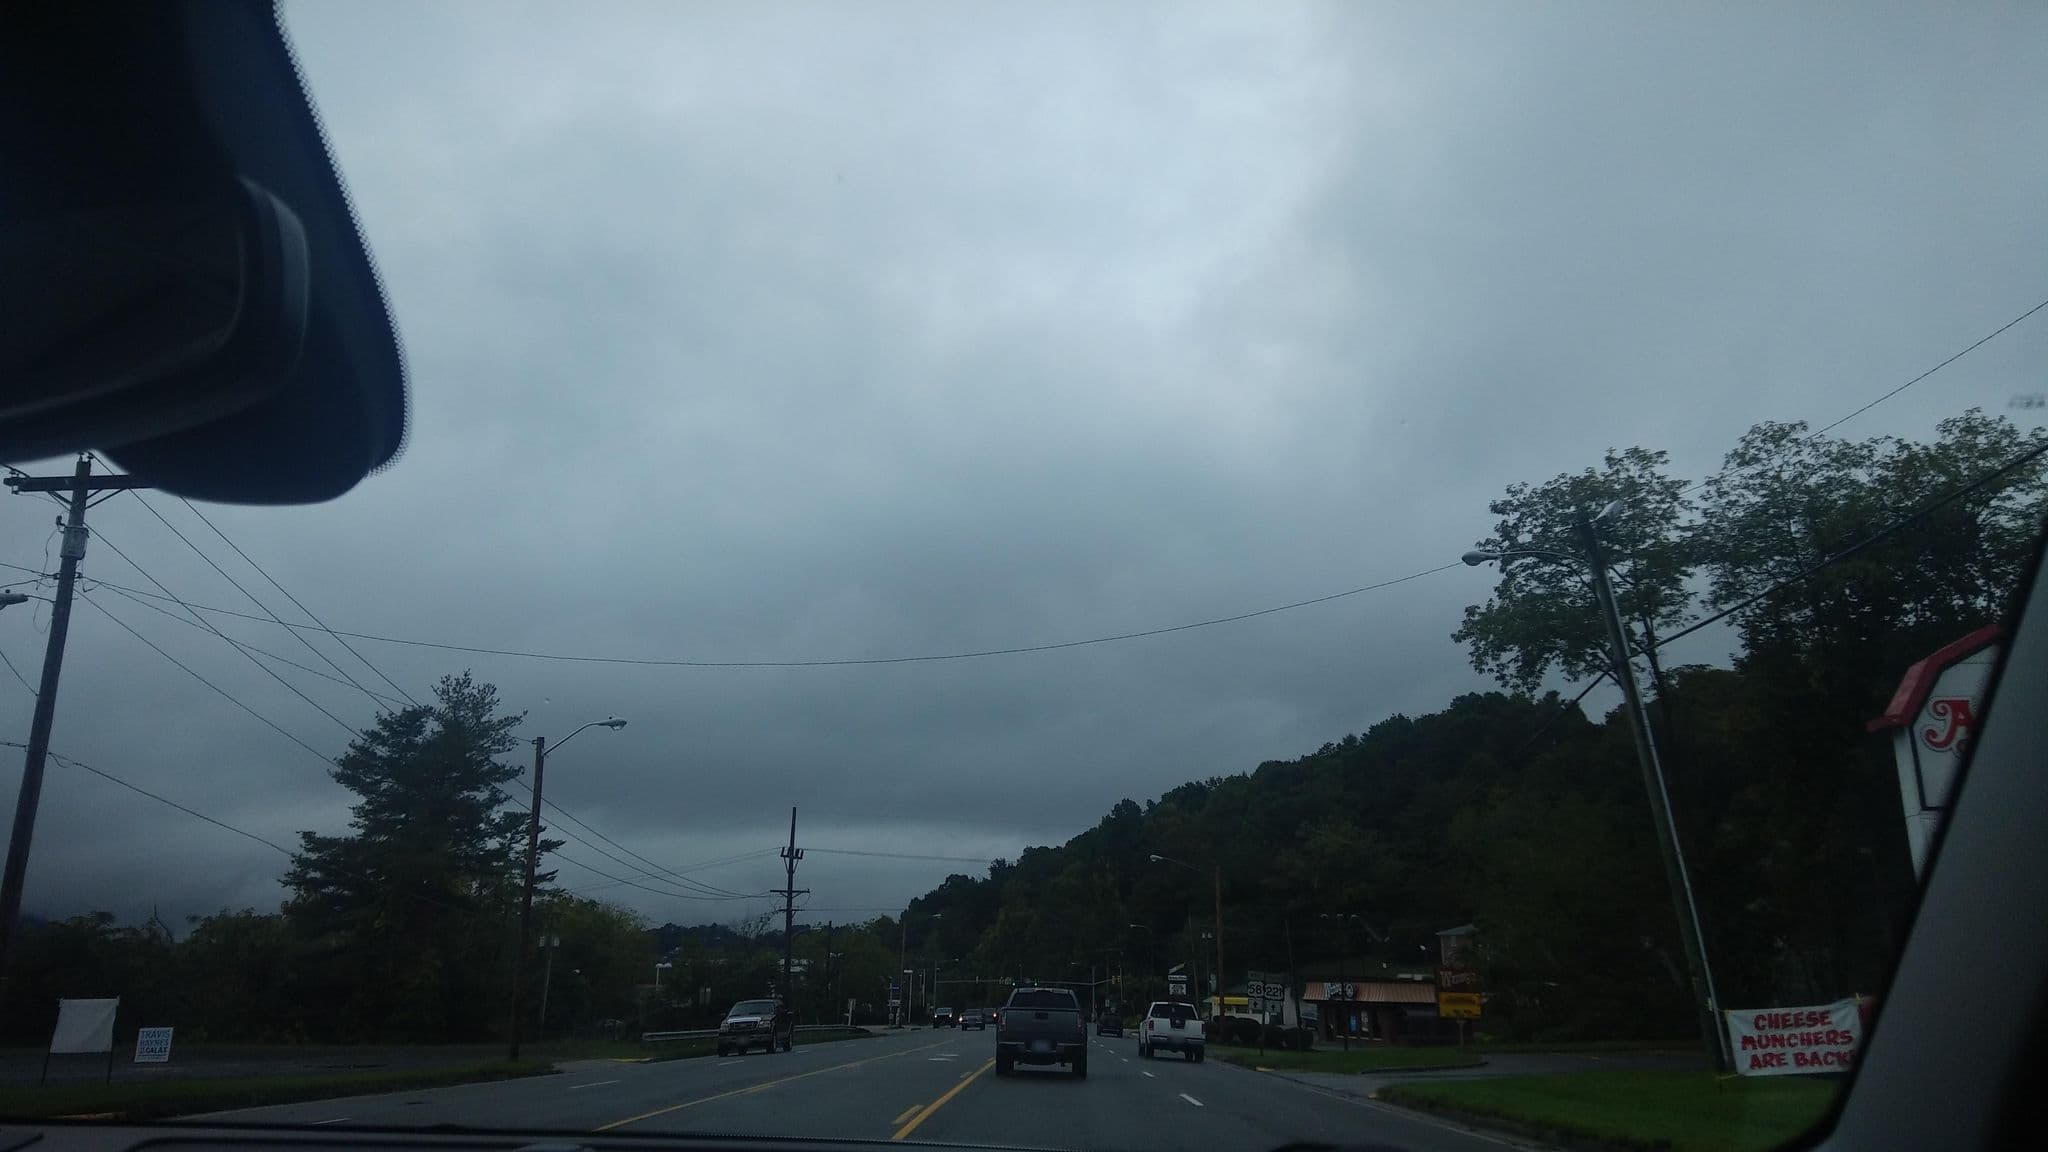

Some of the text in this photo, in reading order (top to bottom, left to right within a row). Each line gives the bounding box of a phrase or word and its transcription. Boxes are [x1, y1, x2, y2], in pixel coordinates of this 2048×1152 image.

[1248, 984, 1262, 995] 58
[1753, 1010, 1833, 1031] CHEESE
[140, 1030, 170, 1039] TRAVIS
[1742, 1030, 1853, 1050] MUNCHERS
[1750, 1052, 1788, 1070] ARE
